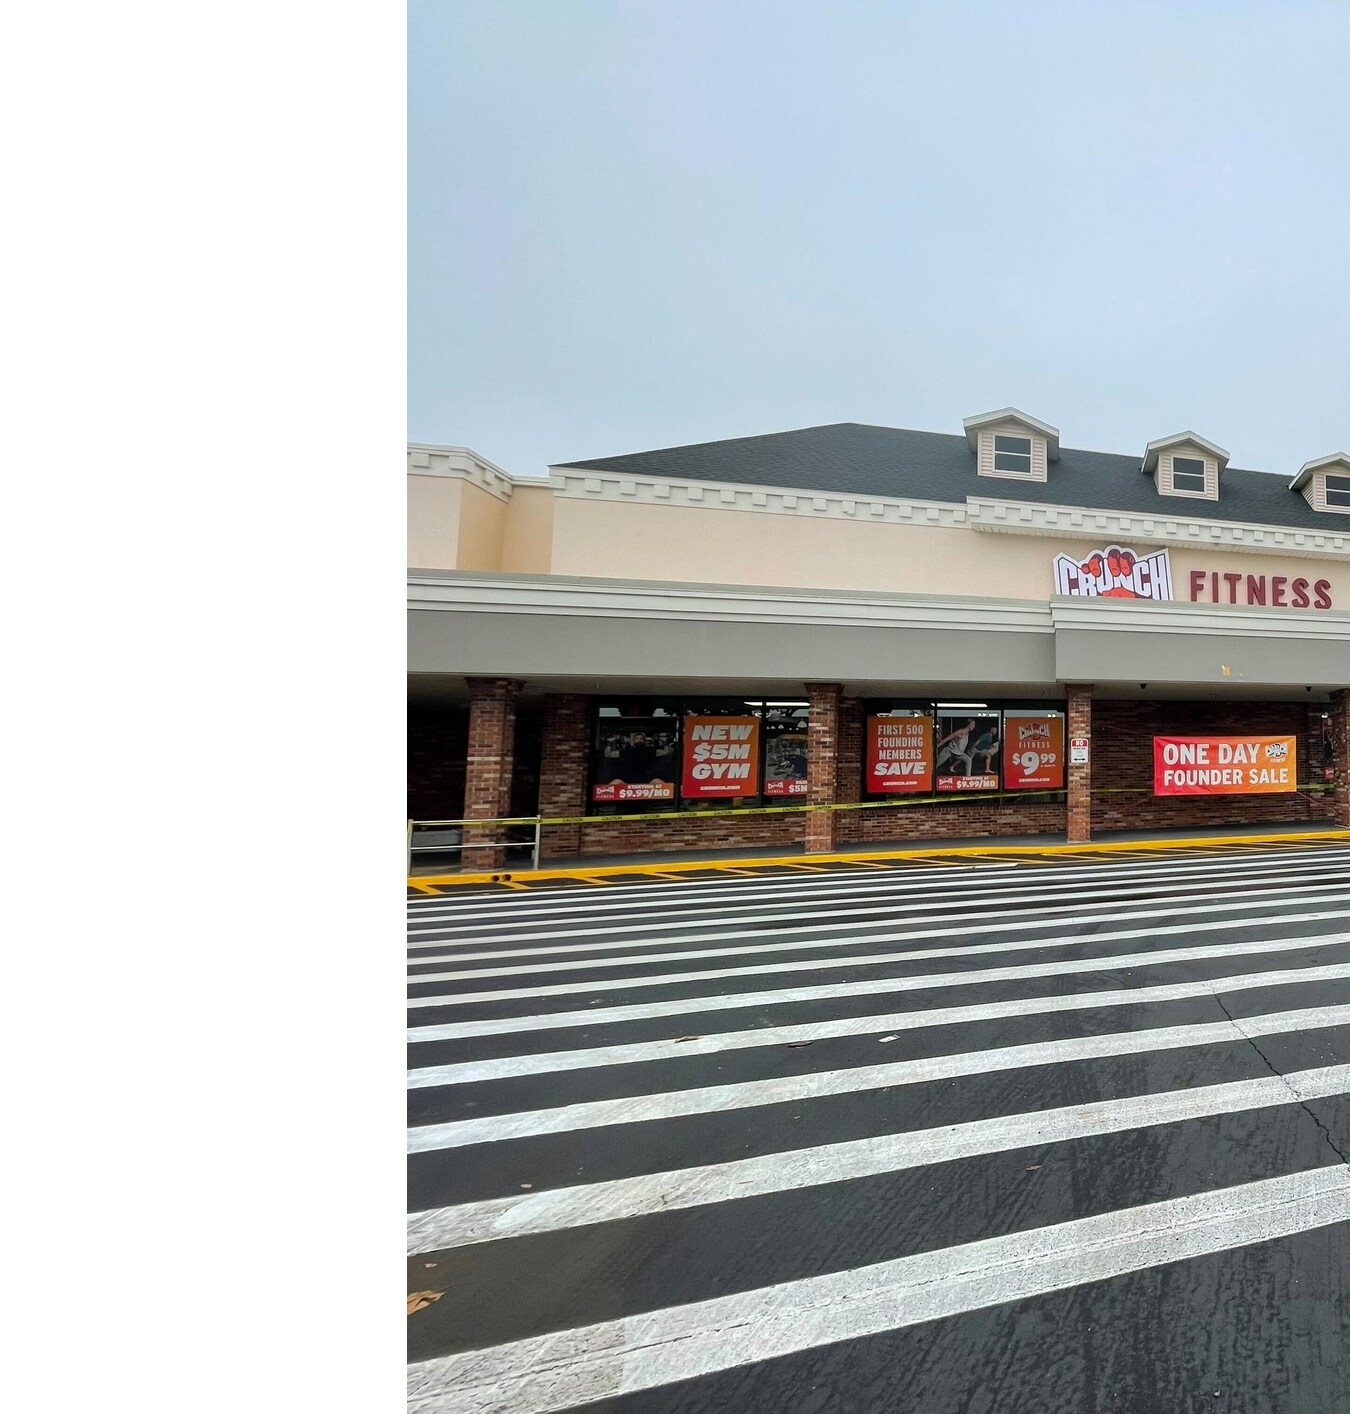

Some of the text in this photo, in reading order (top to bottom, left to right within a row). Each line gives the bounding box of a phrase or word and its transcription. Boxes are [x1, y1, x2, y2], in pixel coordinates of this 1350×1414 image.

[1055, 551, 1333, 609] CRUNCH FITNESS
[691, 724, 754, 741] NEW
[877, 724, 924, 735] FIRST 500
[877, 736, 924, 747] FOUNDING
[693, 742, 752, 762] $5M
[878, 749, 922, 760] MEMBERS
[1163, 743, 1261, 765] ONE DAY
[691, 763, 752, 779] GYM
[873, 762, 927, 776] SAVE
[956, 780, 996, 789] $9.99/MO
[1164, 768, 1289, 786] FOUNDER SALE
[619, 788, 671, 798] $9.99/MO
